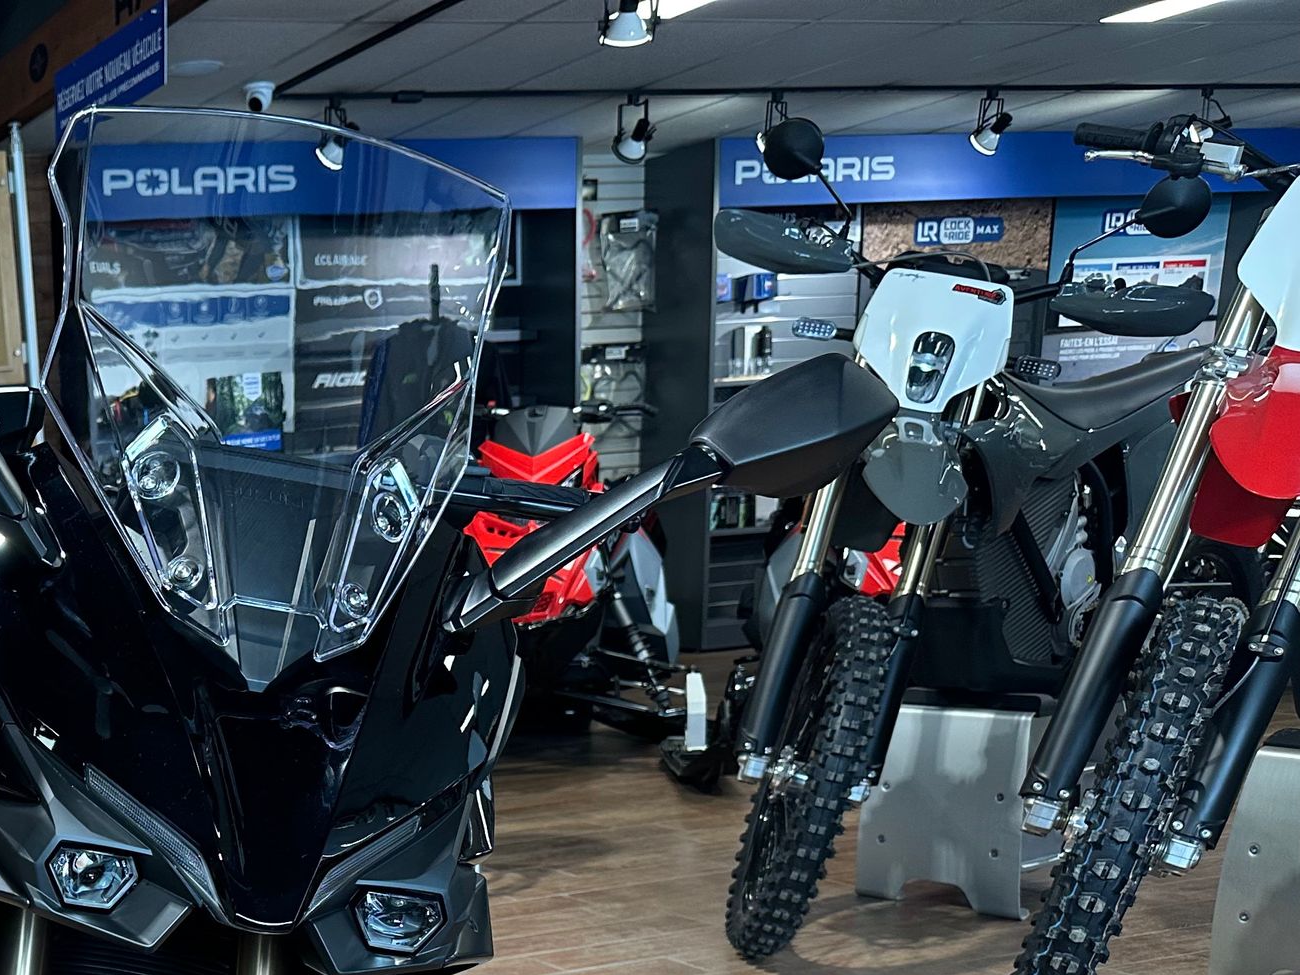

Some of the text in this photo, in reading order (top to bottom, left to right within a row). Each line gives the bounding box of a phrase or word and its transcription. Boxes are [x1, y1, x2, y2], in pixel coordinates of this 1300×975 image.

[102, 164, 297, 197] POLARIS
[734, 156, 895, 186] PARIS
[917, 220, 971, 243] LR LOCK
[975, 225, 999, 235] MAX
